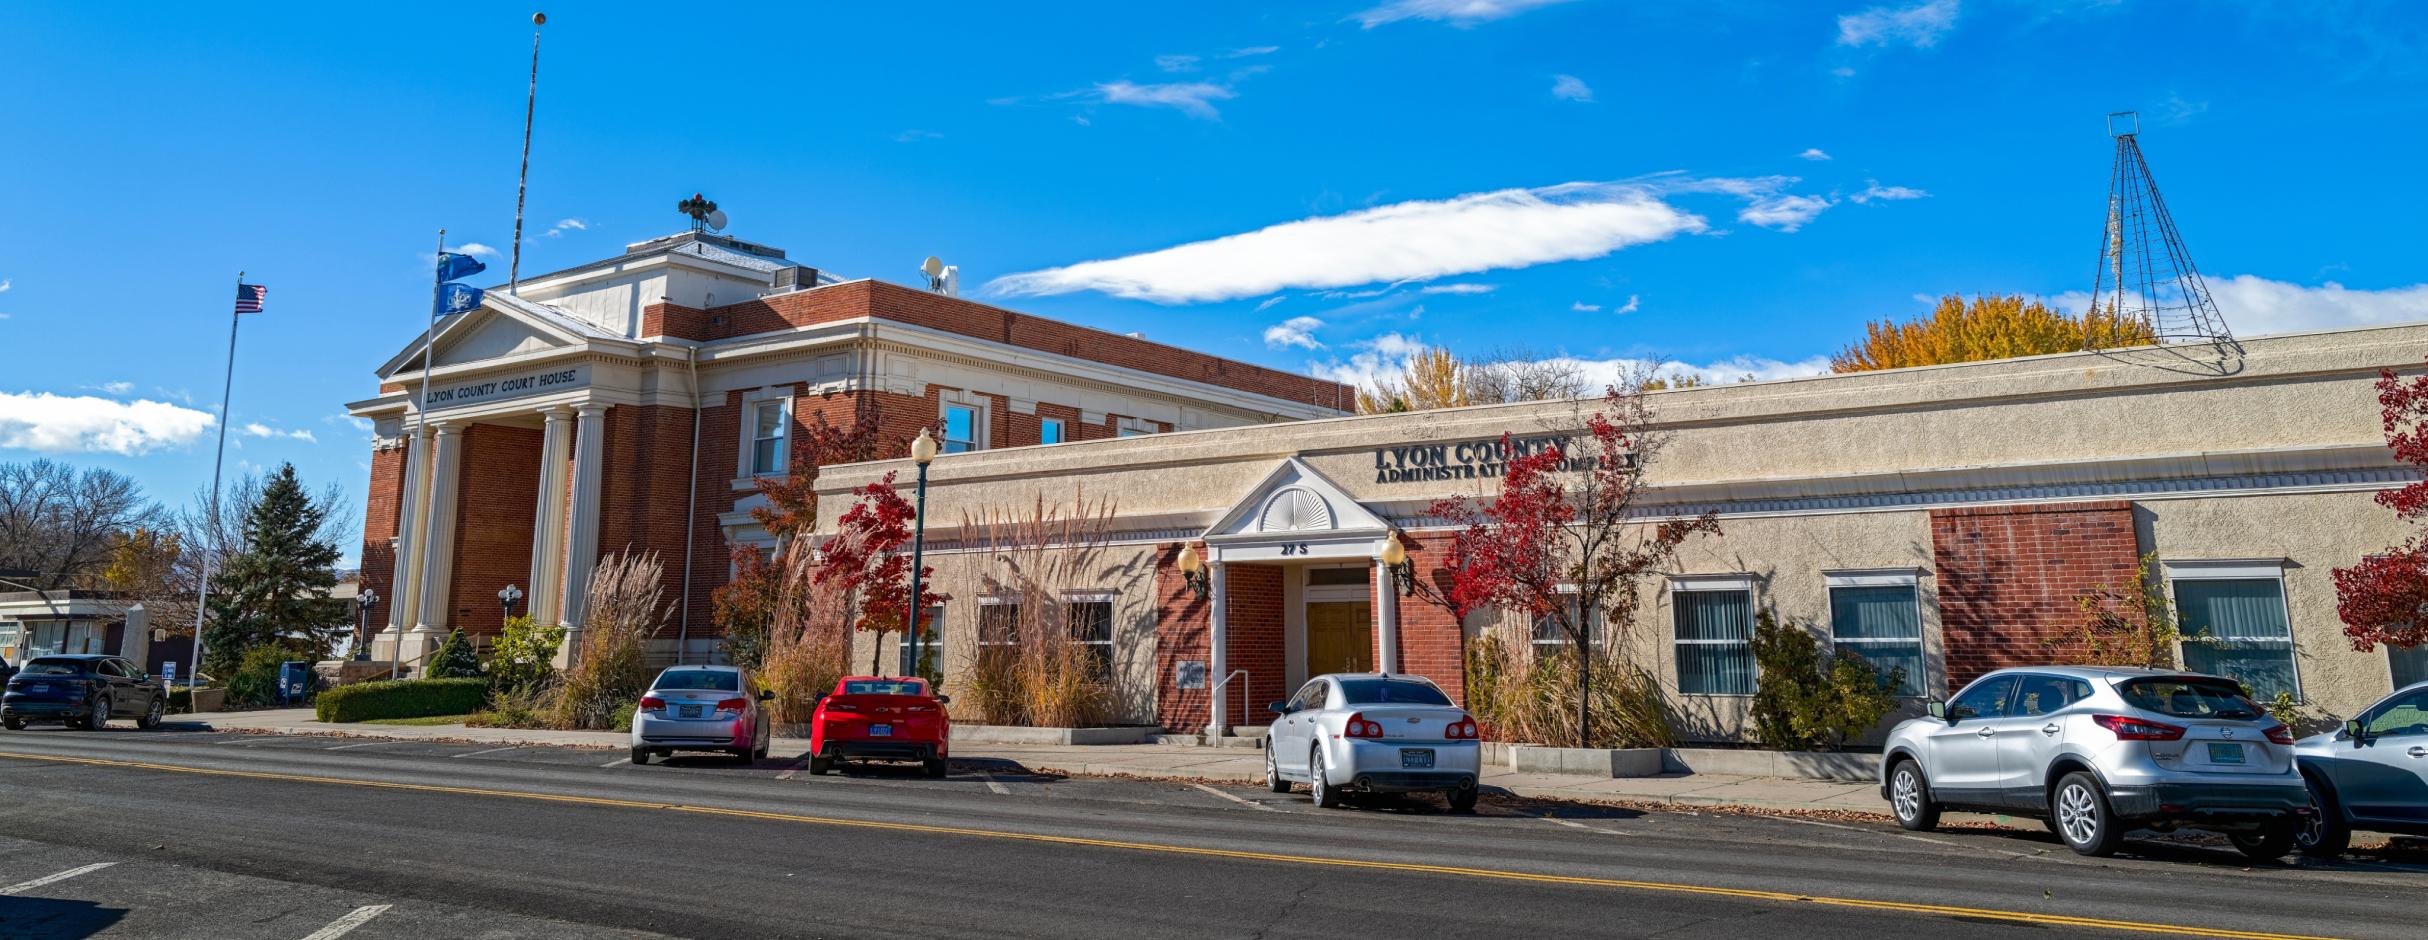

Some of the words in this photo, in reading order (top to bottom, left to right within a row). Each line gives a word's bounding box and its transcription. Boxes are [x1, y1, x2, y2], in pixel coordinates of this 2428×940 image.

[426, 389, 454, 404] LYON
[457, 382, 497, 399] COUNTY
[501, 376, 536, 392] COURT
[539, 369, 576, 387] HOUSE
[1375, 443, 1449, 469] LYON
[1376, 461, 1511, 484] ADMINISTRATI
[1280, 543, 1296, 556] 27
[1299, 543, 1309, 556] S
